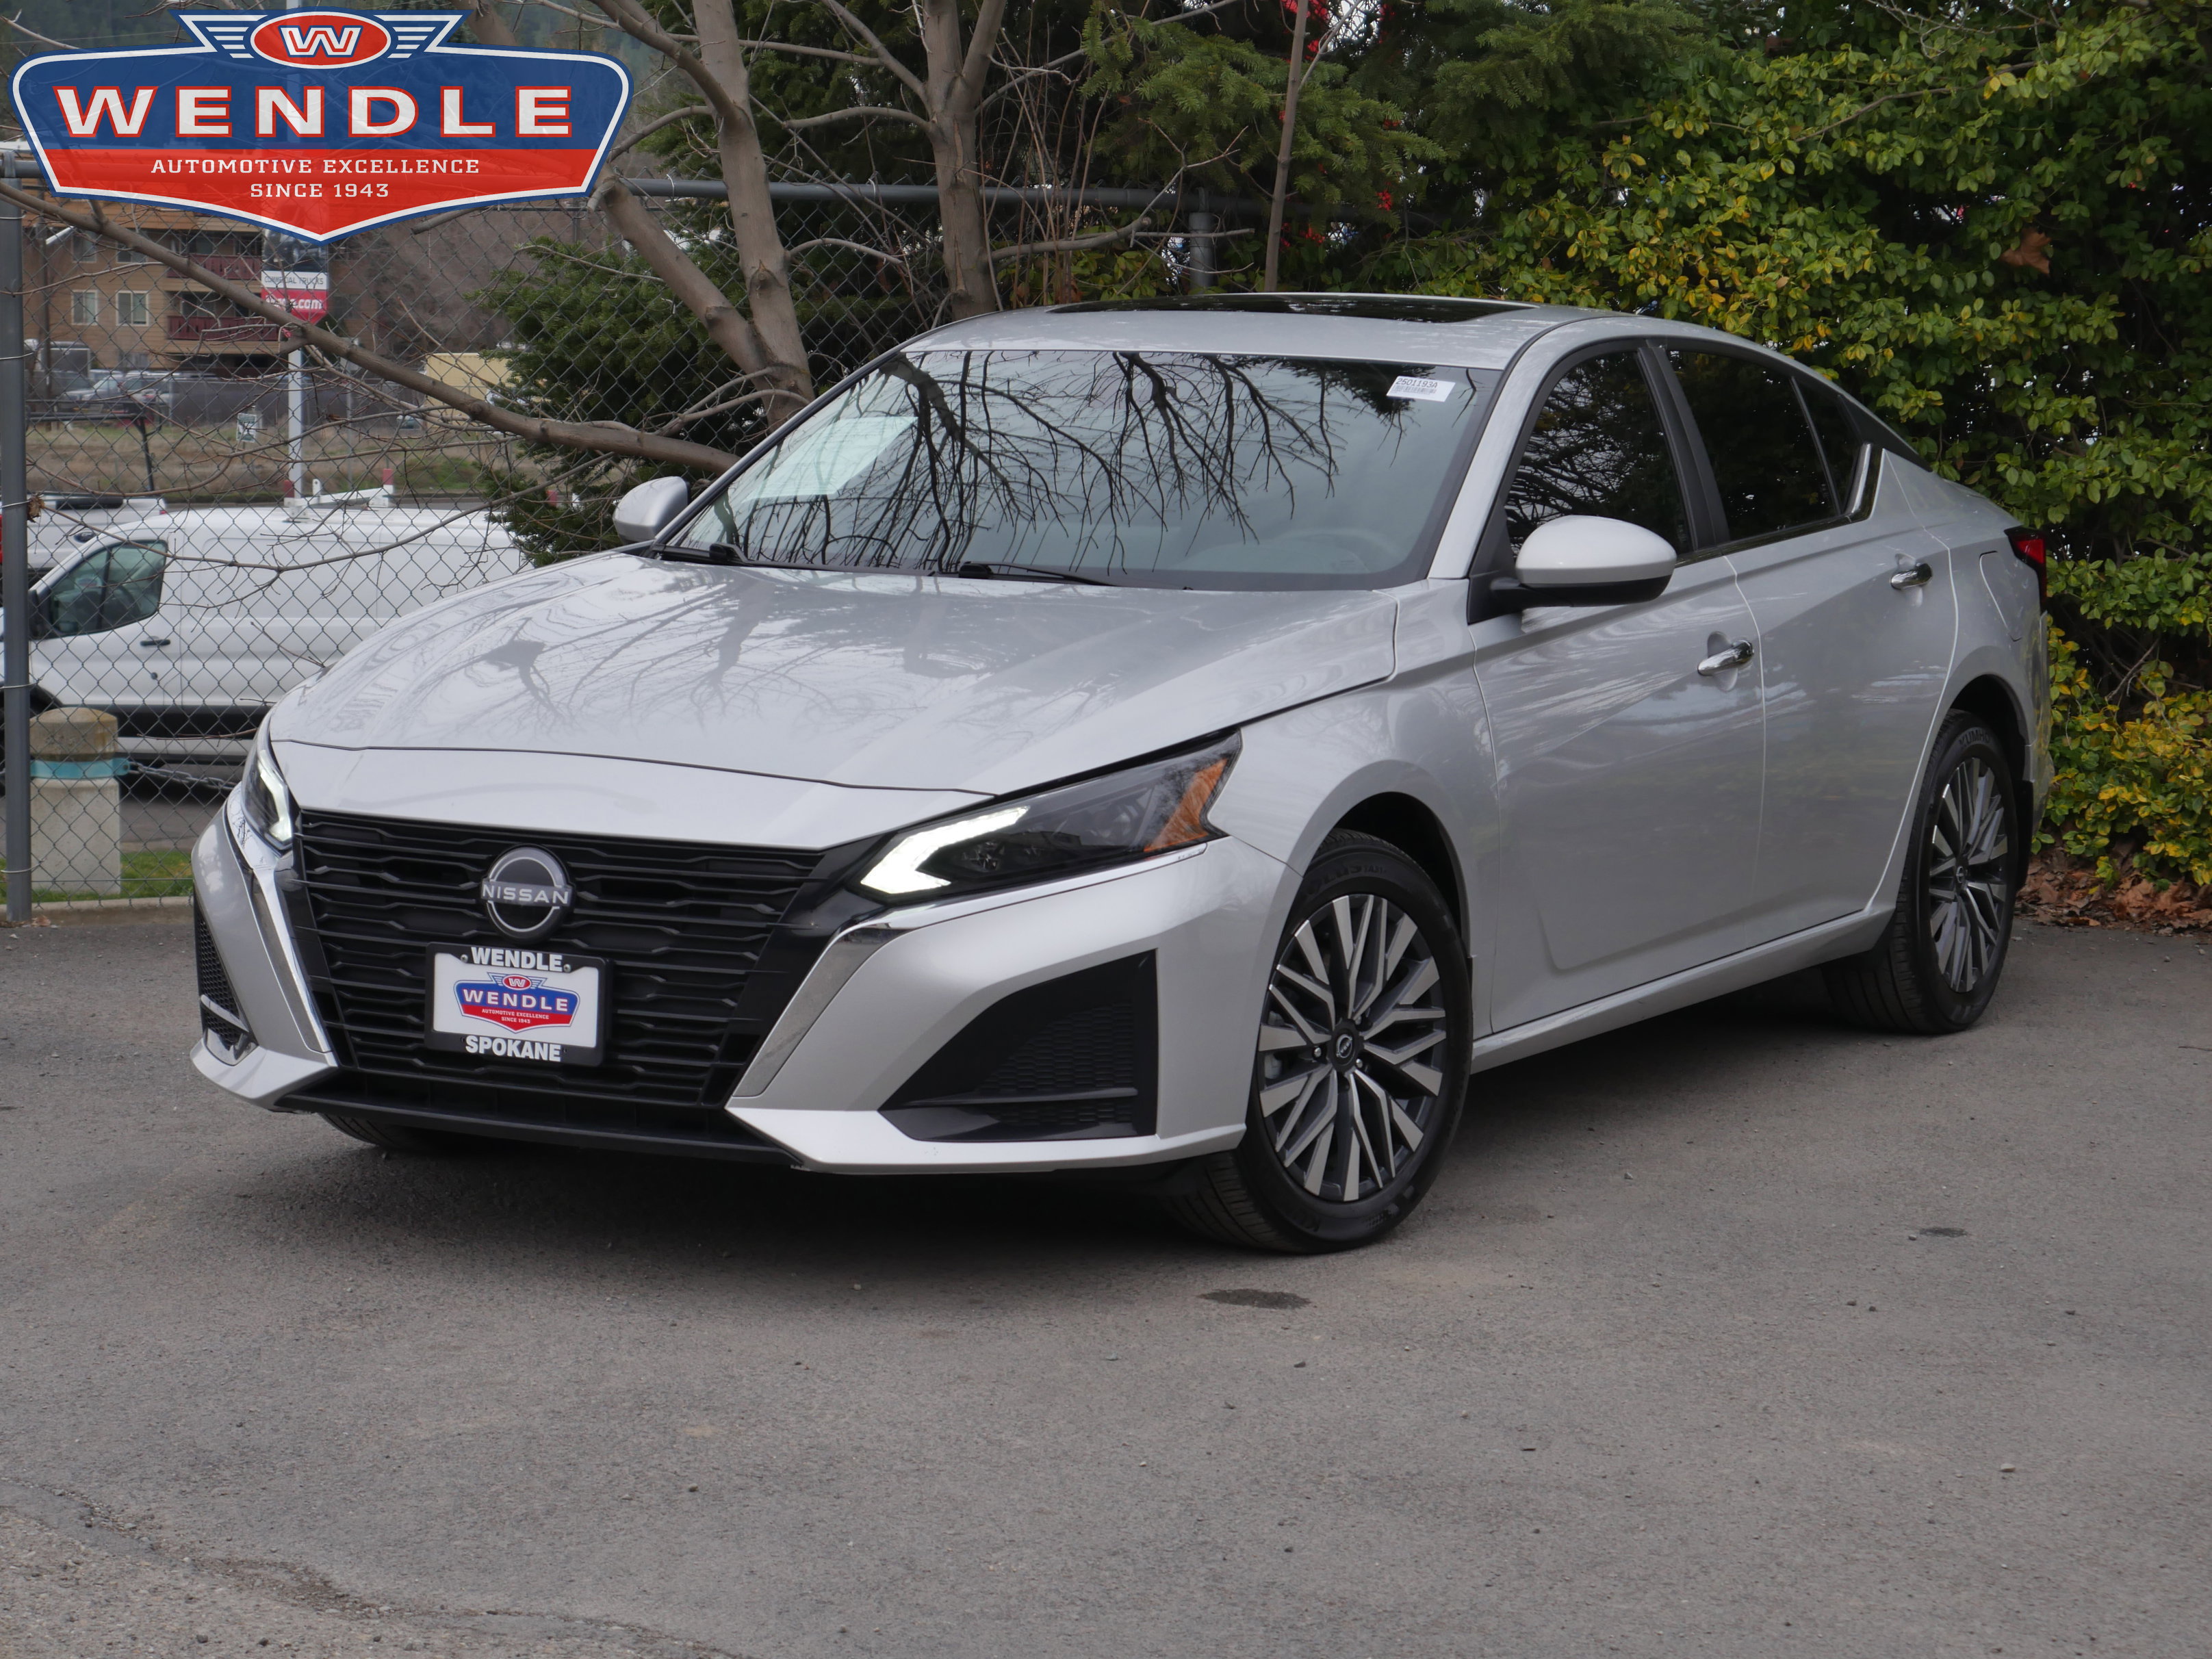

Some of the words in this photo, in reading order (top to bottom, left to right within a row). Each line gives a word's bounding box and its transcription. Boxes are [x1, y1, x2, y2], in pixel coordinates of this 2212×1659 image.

[1396, 378, 1438, 388] 2501193A
[482, 884, 569, 904] NISSAN
[471, 947, 563, 972] WENDLE
[462, 989, 569, 1012] WENDLE
[465, 1035, 561, 1062] SPOKANE
